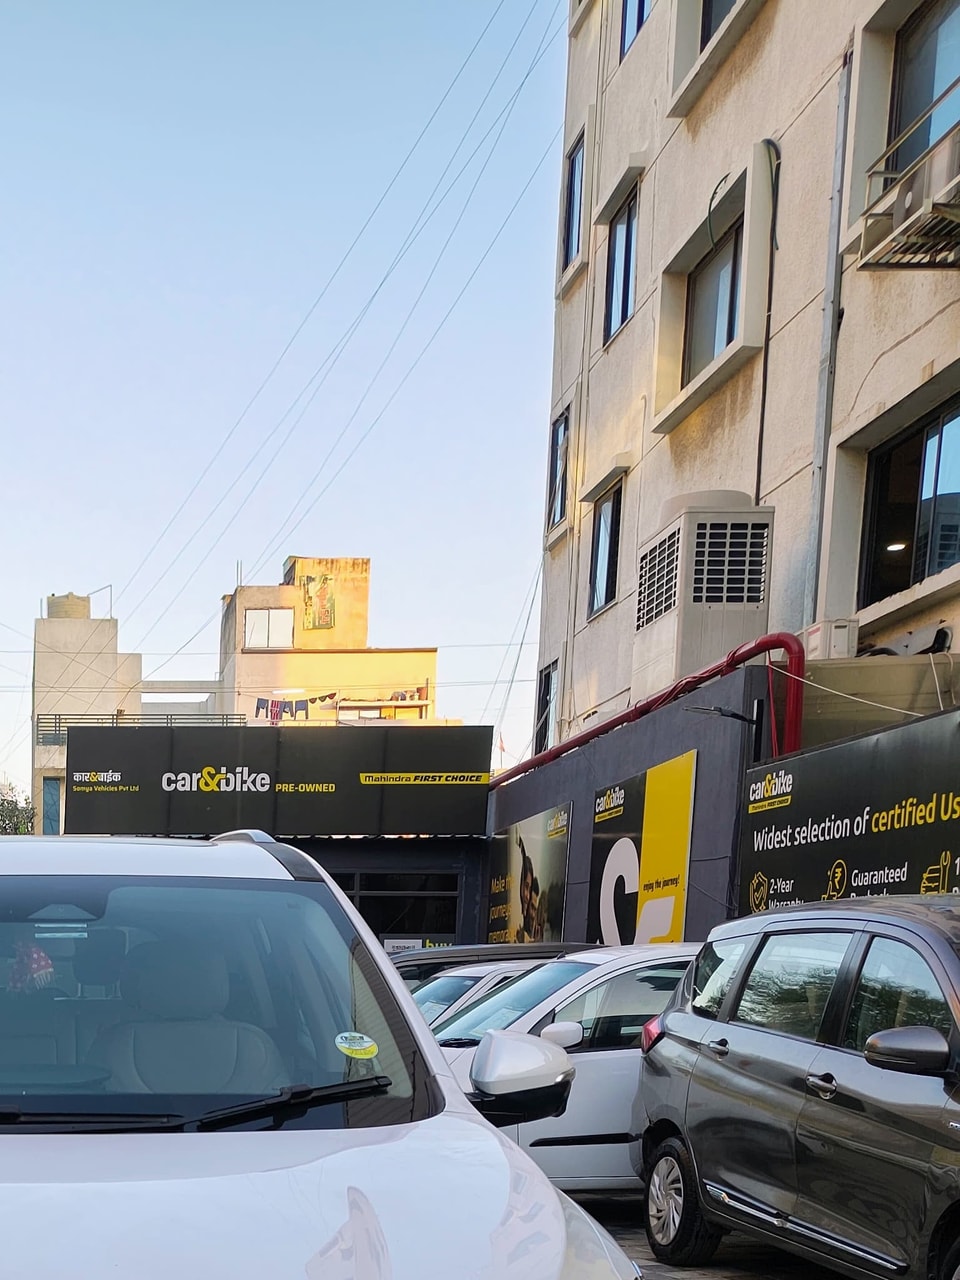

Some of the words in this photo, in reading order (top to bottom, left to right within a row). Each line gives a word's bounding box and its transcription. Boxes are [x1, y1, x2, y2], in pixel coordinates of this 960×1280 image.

[161, 766, 271, 792] car&bike
[275, 783, 336, 793] PRE-OWNED
[364, 774, 411, 783] Mahindra
[413, 774, 443, 783] FIRST
[445, 774, 483, 783] CHOICE
[749, 769, 794, 801] car&bike
[72, 785, 93, 793] Somya
[94, 785, 118, 793] Vehicles
[119, 785, 129, 793] Pvt
[130, 785, 140, 793] Ltd
[754, 825, 792, 851] Widest
[794, 814, 850, 846] selection
[853, 806, 870, 836] of
[871, 793, 937, 832] certified
[851, 862, 908, 886] Guaranteed
[769, 879, 794, 894] 2-Year
